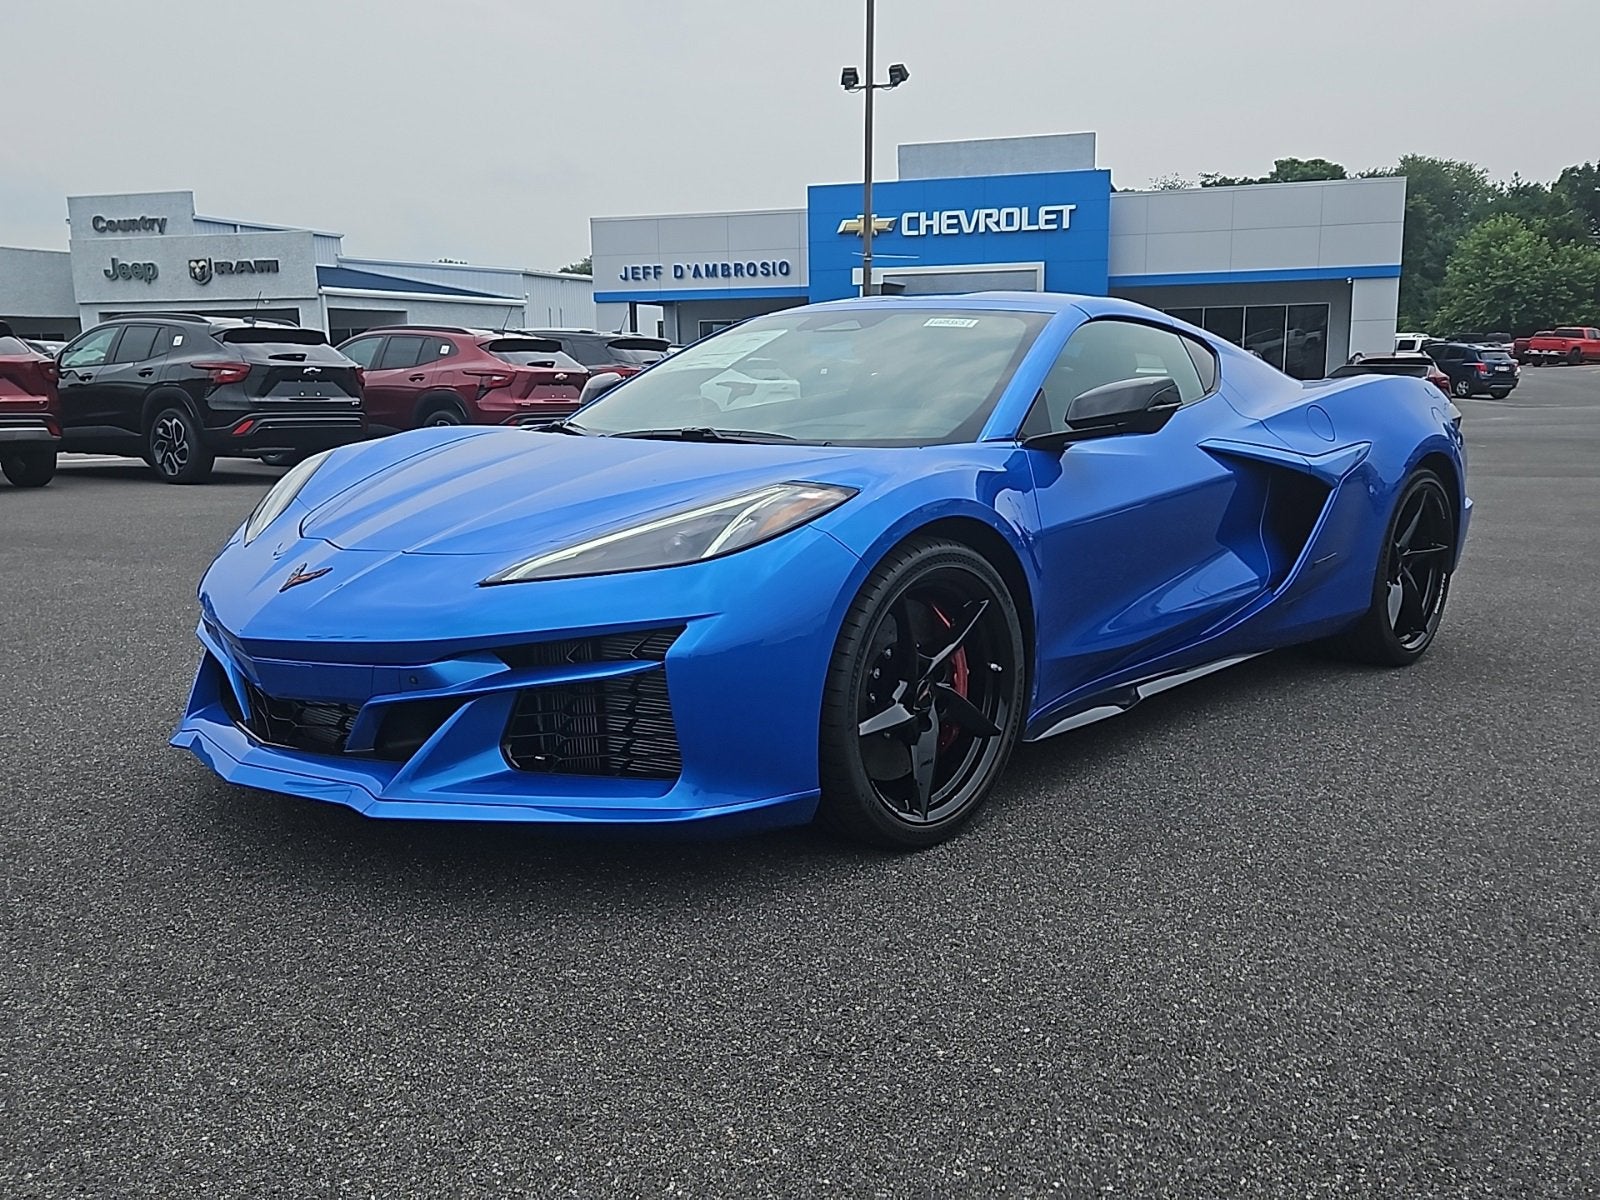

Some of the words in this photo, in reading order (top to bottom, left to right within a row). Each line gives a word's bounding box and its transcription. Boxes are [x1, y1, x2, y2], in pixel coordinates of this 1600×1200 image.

[92, 215, 168, 235] Country
[901, 204, 1077, 236] CHEVROLET
[103, 257, 159, 284] Jeep
[214, 259, 279, 274] RAM
[619, 265, 663, 281] JEFF
[673, 260, 791, 279] D'AMBROSIO
